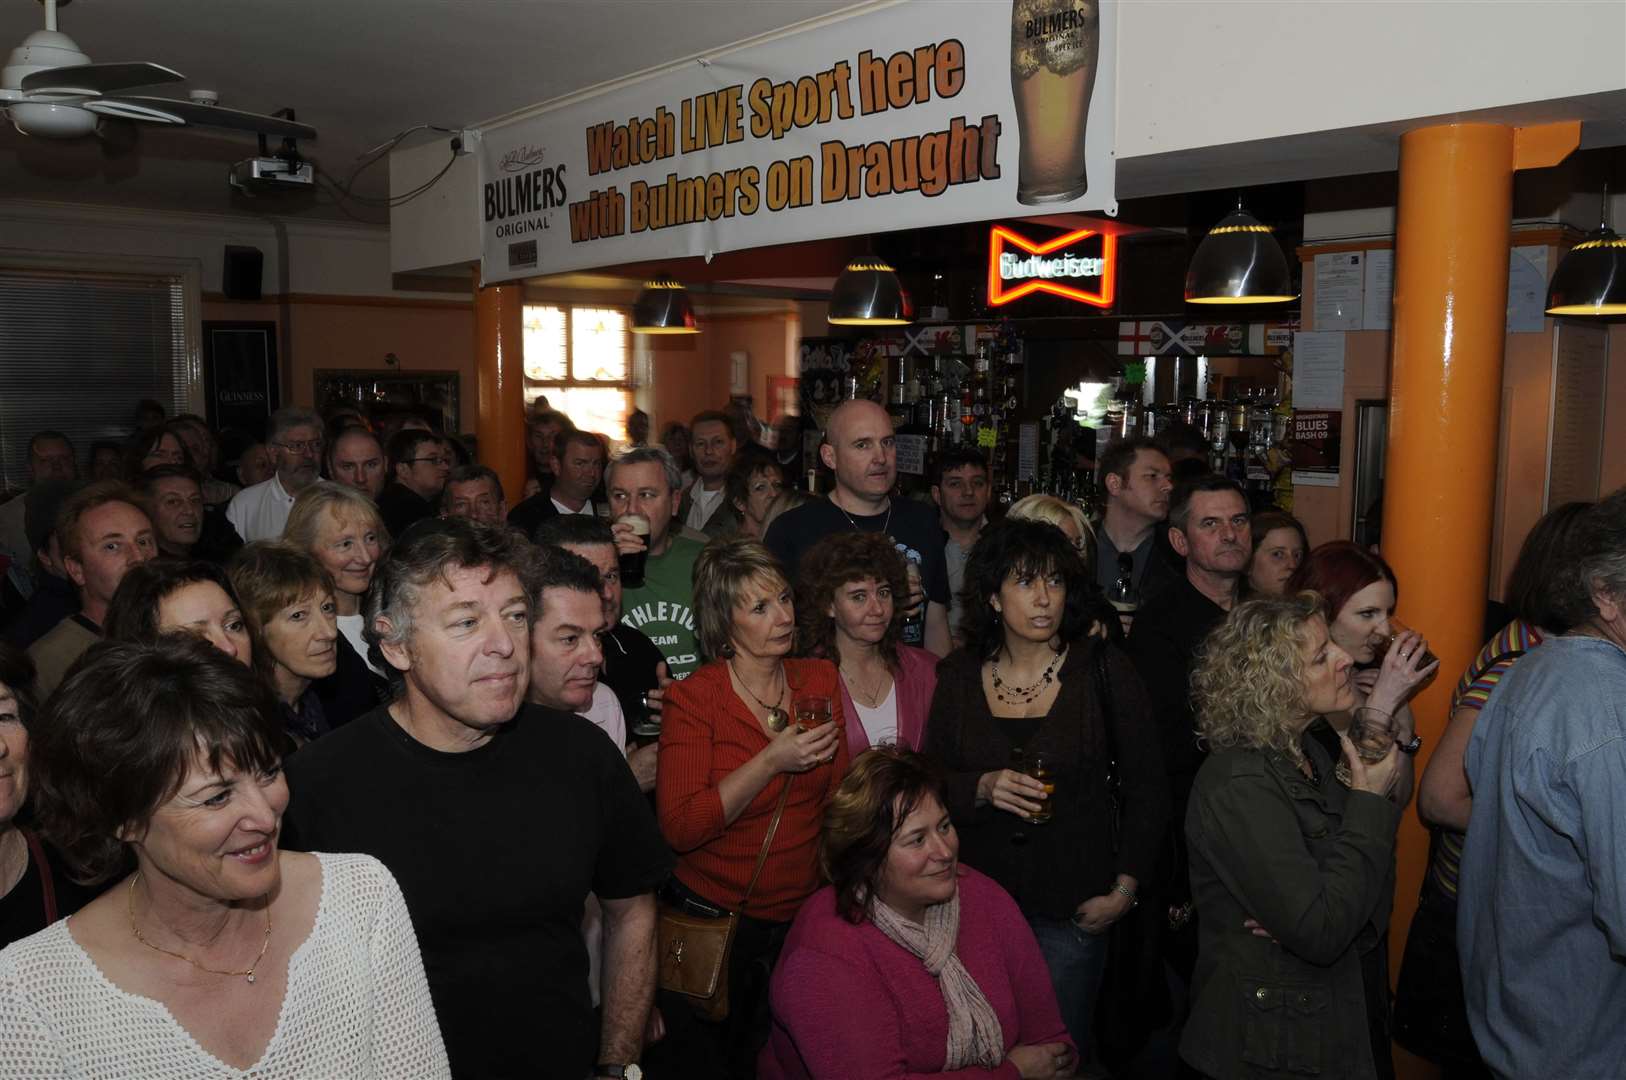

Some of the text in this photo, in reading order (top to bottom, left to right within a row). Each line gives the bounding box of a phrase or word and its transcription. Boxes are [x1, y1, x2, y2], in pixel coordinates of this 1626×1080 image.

[1025, 8, 1084, 38] BULMERS
[586, 38, 965, 176] Watch LIVE Sport here
[484, 163, 567, 222] BULMERS
[569, 114, 1002, 243] with Bulmers on Draught
[496, 216, 550, 238] ORIGINAL
[1000, 252, 1105, 280] Budweiser
[1296, 420, 1328, 431] BLUES
[1296, 431, 1316, 440] BASH
[621, 601, 696, 631] THLETIC
